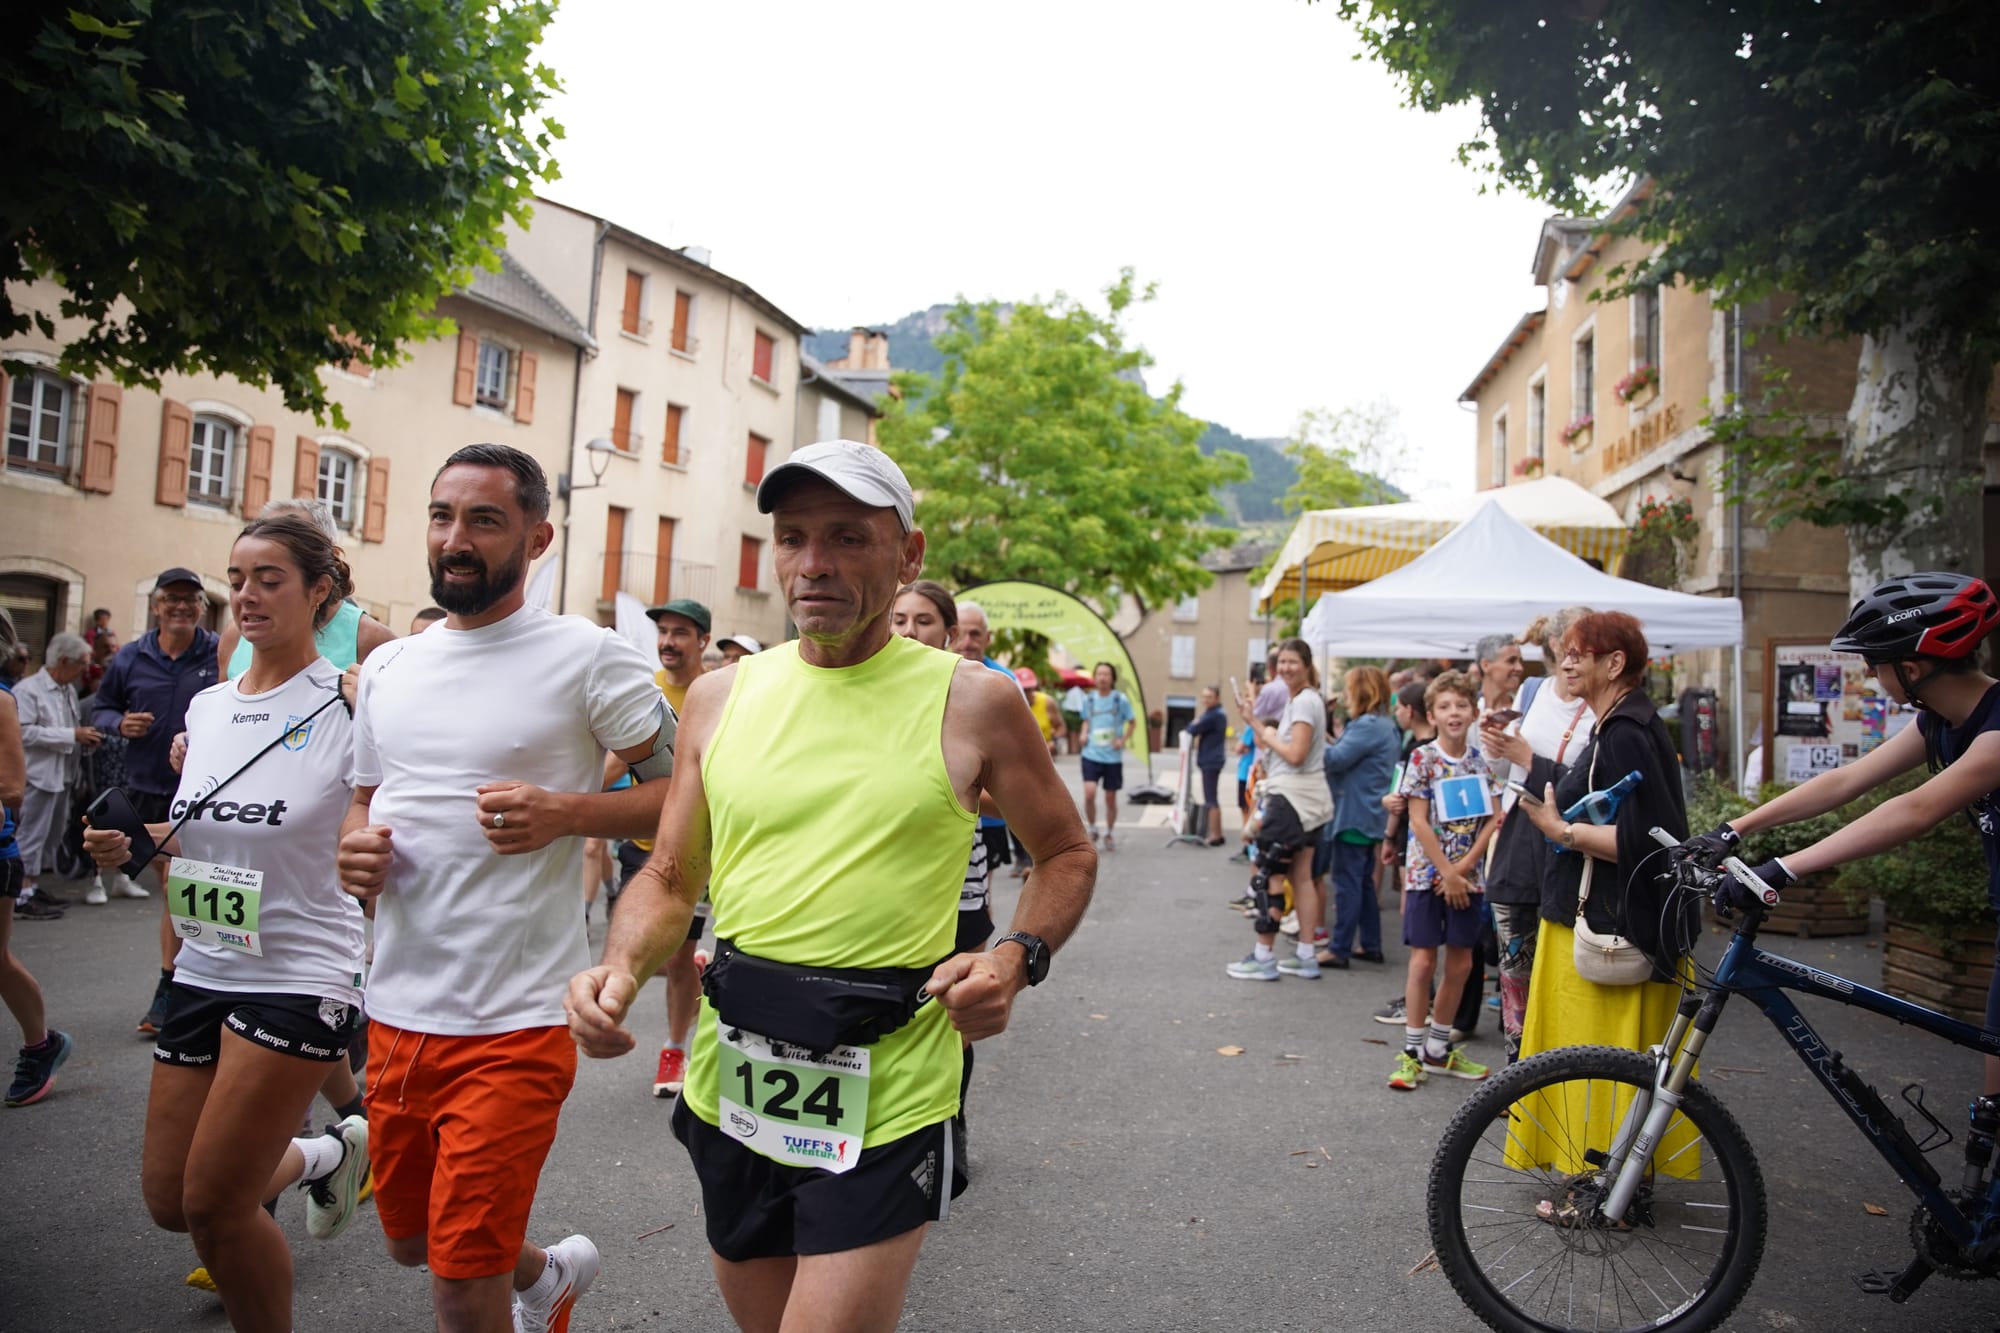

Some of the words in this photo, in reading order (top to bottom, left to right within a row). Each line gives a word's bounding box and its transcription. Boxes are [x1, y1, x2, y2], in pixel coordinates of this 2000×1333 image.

[1602, 403, 1681, 474] MAIRIE
[232, 713, 270, 725] Kempa
[1458, 789, 1469, 807] 1
[171, 792, 289, 826] circet
[181, 883, 245, 926] 113
[253, 1028, 290, 1048] Kempa
[179, 1051, 212, 1064] Kempa
[300, 1042, 331, 1058] Kempa
[783, 1050, 810, 1062] llées
[839, 1049, 857, 1059] des
[736, 1061, 844, 1127] 124
[783, 1135, 834, 1153] TUFF'S
[787, 1145, 837, 1161] Aventure
